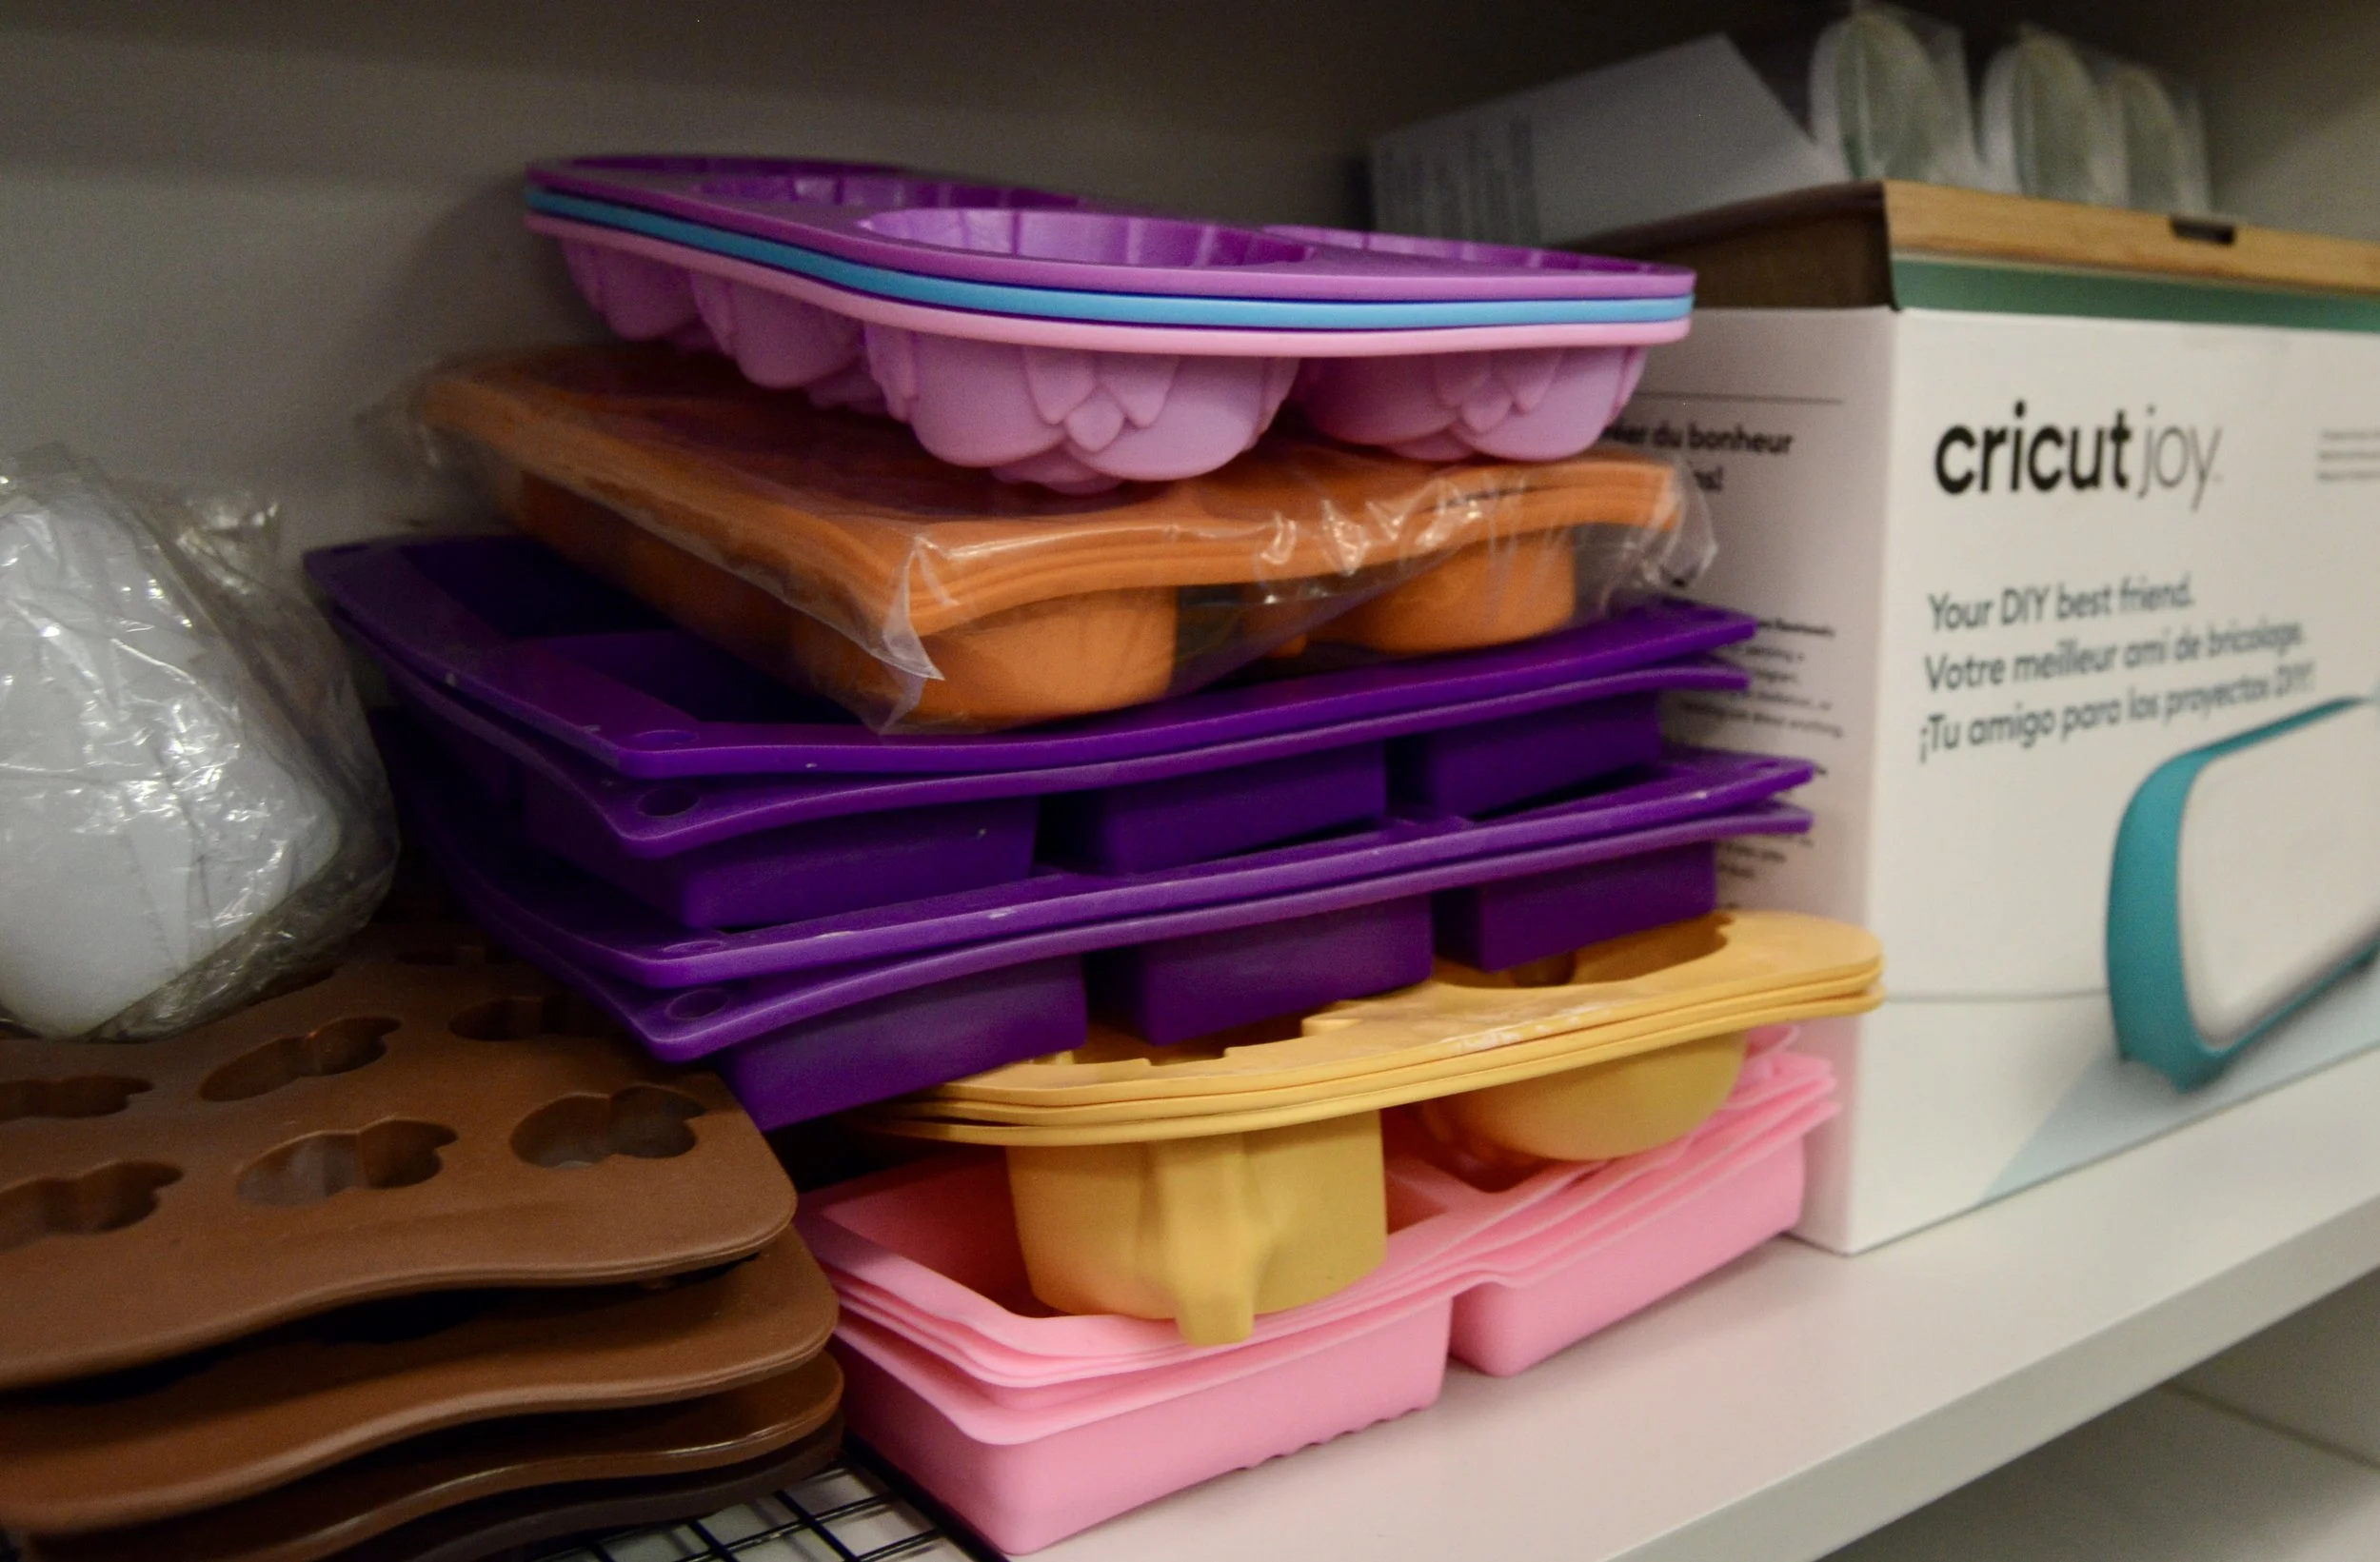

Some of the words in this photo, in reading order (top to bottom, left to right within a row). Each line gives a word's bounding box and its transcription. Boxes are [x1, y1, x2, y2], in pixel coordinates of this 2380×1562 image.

[1688, 420, 1793, 455] bonheur
[1934, 398, 2132, 496] cricut
[1927, 591, 1993, 632] Your
[1999, 584, 2052, 626] DIY
[2055, 582, 2112, 621] best
[2119, 572, 2197, 614] friend.
[1924, 652, 2006, 693] Votre
[2012, 637, 2117, 683] meilleur
[2123, 627, 2171, 668] ami
[2174, 626, 2201, 662] de
[1918, 712, 1961, 764] ¡Tu
[1967, 700, 2054, 749] amigo
[2060, 698, 2122, 742] para
[2127, 684, 2160, 721] los
[2165, 675, 2270, 727] proyectos
